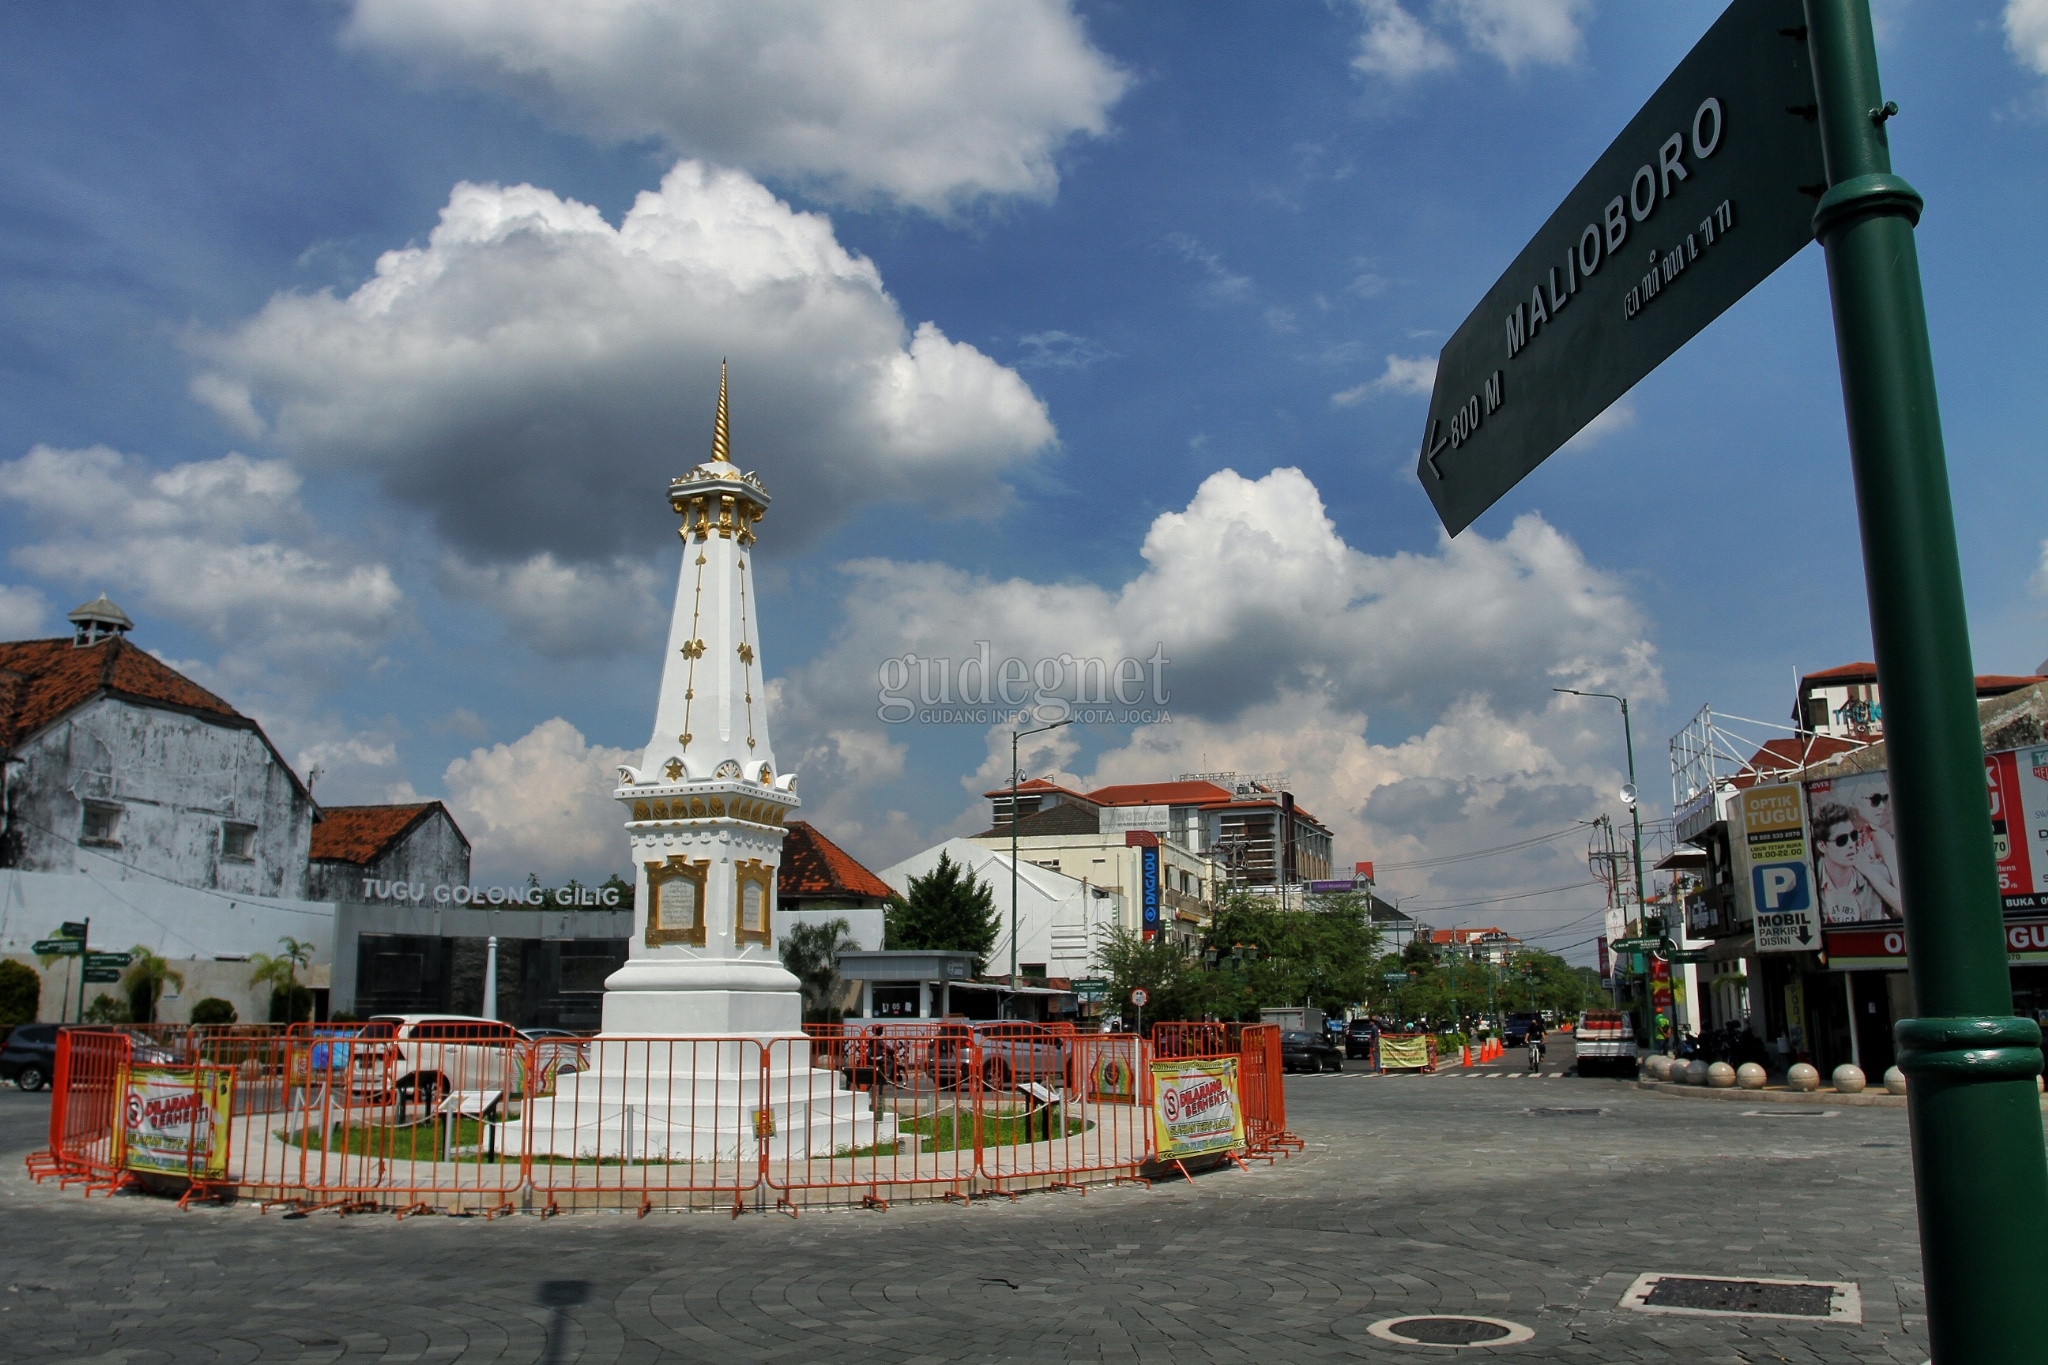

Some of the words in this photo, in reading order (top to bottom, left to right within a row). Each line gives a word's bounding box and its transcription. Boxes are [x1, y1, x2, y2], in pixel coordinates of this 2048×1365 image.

[1506, 97, 1722, 359] MALIOBORO
[1451, 394, 1479, 449] 800
[1485, 369, 1501, 417] M
[1750, 796, 1792, 811] OPTIK
[1748, 808, 1799, 826] TUGU
[1752, 849, 1802, 859] 09.00-22.00
[1145, 852, 1156, 905] DAGADU
[1762, 867, 1797, 909] P
[362, 878, 425, 900] TUGU
[433, 884, 543, 905] GOLONG
[555, 886, 620, 906] GILIG
[2006, 898, 2035, 907] BUKA
[1757, 914, 1811, 928] MOBIL
[1759, 925, 1798, 937] PARKIR
[1760, 936, 1791, 947] DISINI
[1180, 1079, 1222, 1108] DILARANG
[1185, 1091, 1229, 1117] BERHENTI
[150, 1107, 208, 1129] BERHETI
